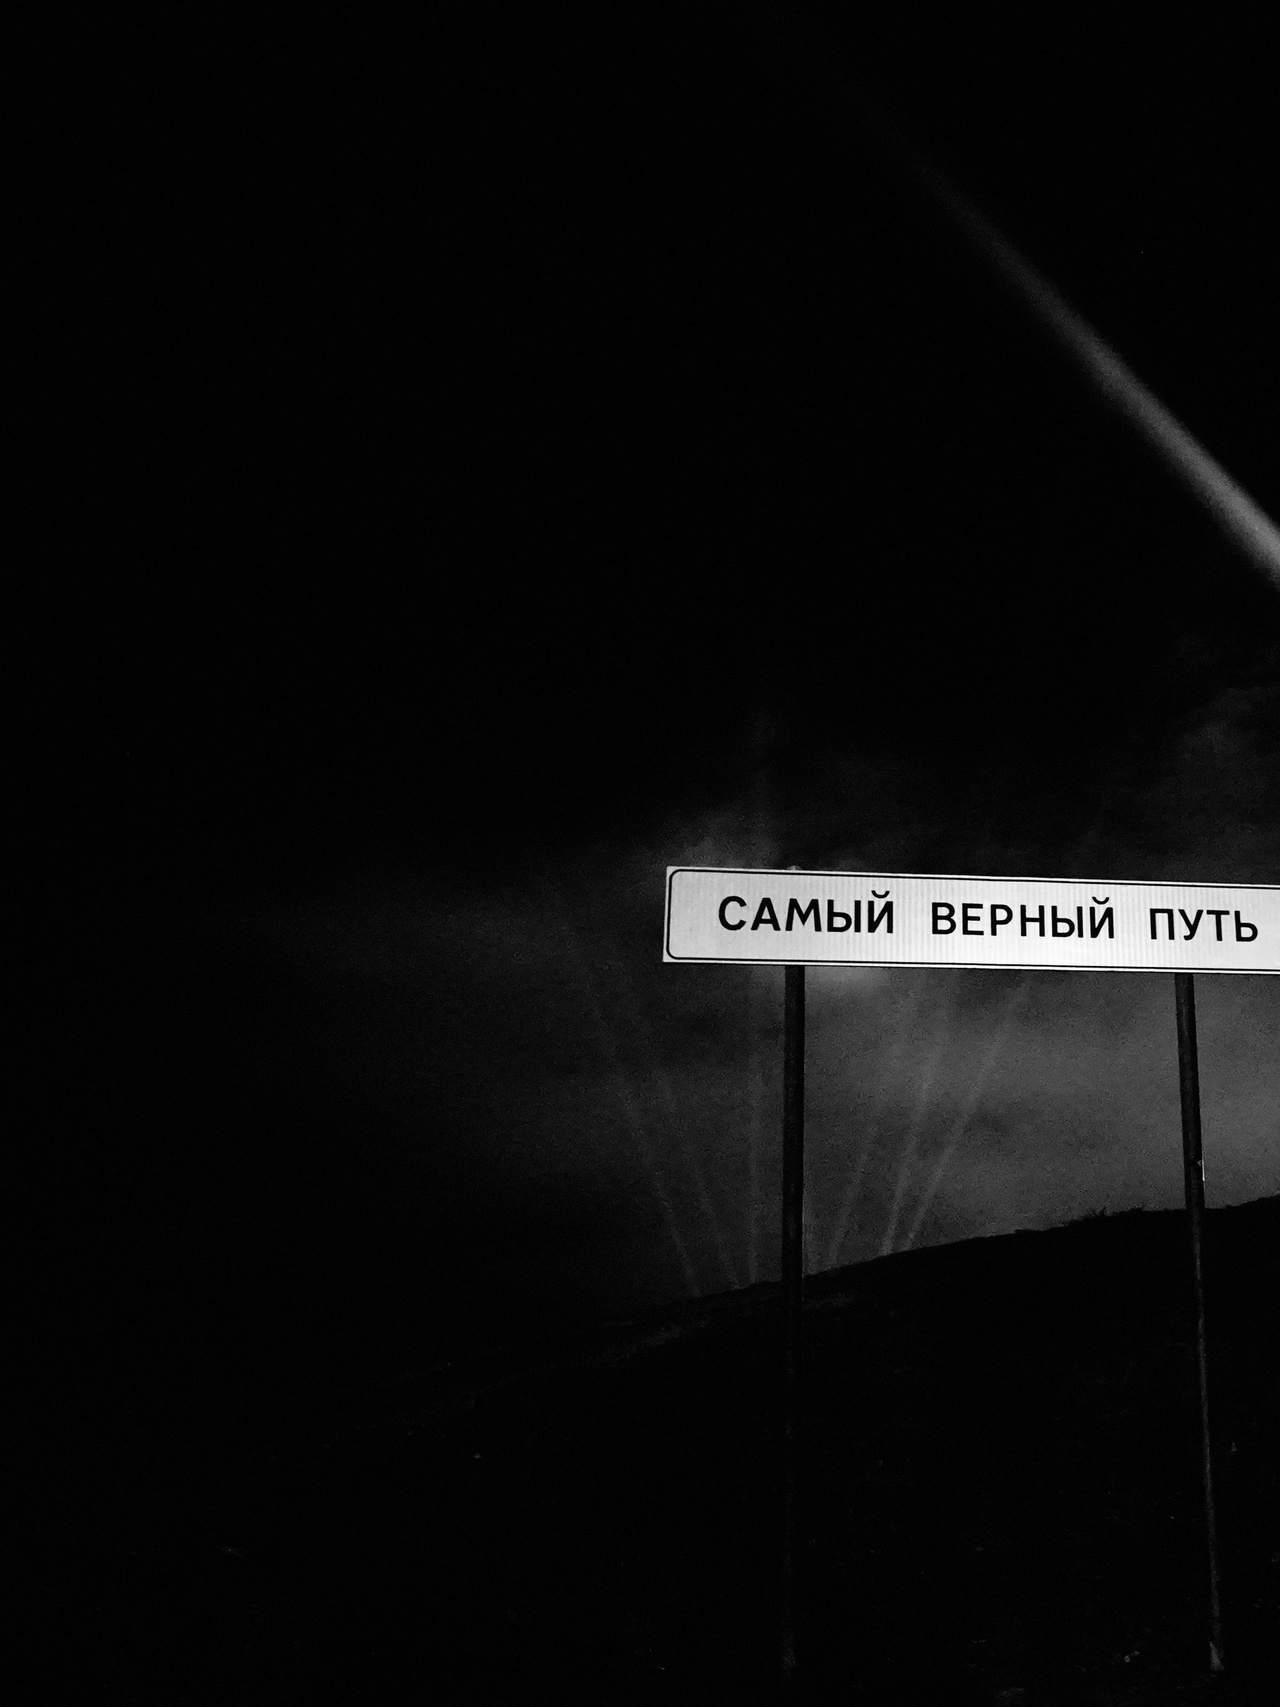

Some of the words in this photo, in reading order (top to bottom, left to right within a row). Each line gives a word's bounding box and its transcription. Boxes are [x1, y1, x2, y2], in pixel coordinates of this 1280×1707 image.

[718, 889, 894, 934] САМЫЙ
[931, 896, 1115, 939] ВЕРНЫЙ
[1149, 907, 1259, 943] ПУТЬ
